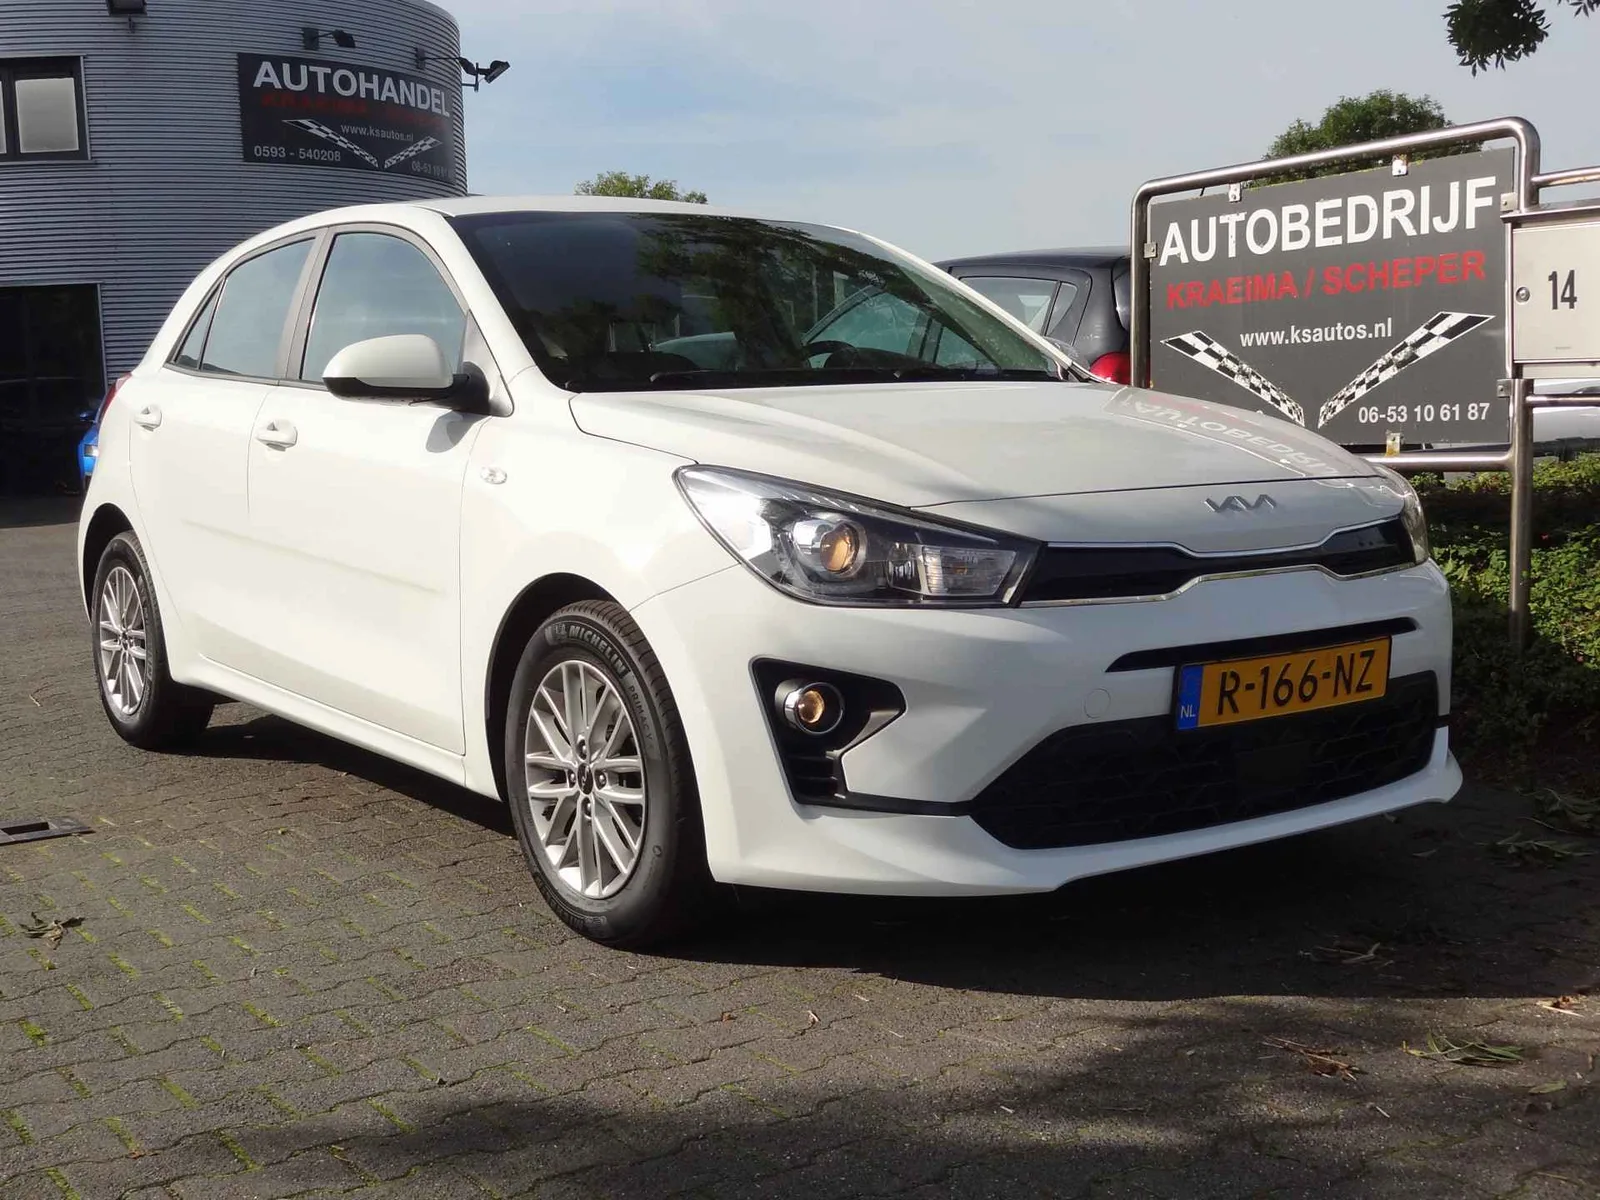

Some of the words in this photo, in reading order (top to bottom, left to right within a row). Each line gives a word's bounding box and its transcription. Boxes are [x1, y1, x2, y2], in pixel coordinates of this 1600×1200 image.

[253, 61, 450, 117] AUTOHANDEL
[341, 124, 414, 142] www.ksautos.nl
[254, 145, 286, 159] 0593
[299, 148, 341, 162] 540208
[1159, 176, 1497, 266] AUTOBEDRIJF
[1166, 271, 1298, 308] KRAEIMA
[1323, 250, 1486, 296] SCHEPER
[1548, 269, 1578, 311] 14
[1240, 317, 1393, 348] www.ksautos.nl
[1358, 404, 1408, 424] 06-53
[1414, 404, 1435, 422] 10
[1440, 403, 1460, 421] 61
[1467, 402, 1490, 421] 87
[1204, 494, 1277, 514] KIA
[569, 624, 631, 679] MICHELIN
[1217, 650, 1376, 716] R-166-NZ
[1180, 705, 1196, 719] NL
